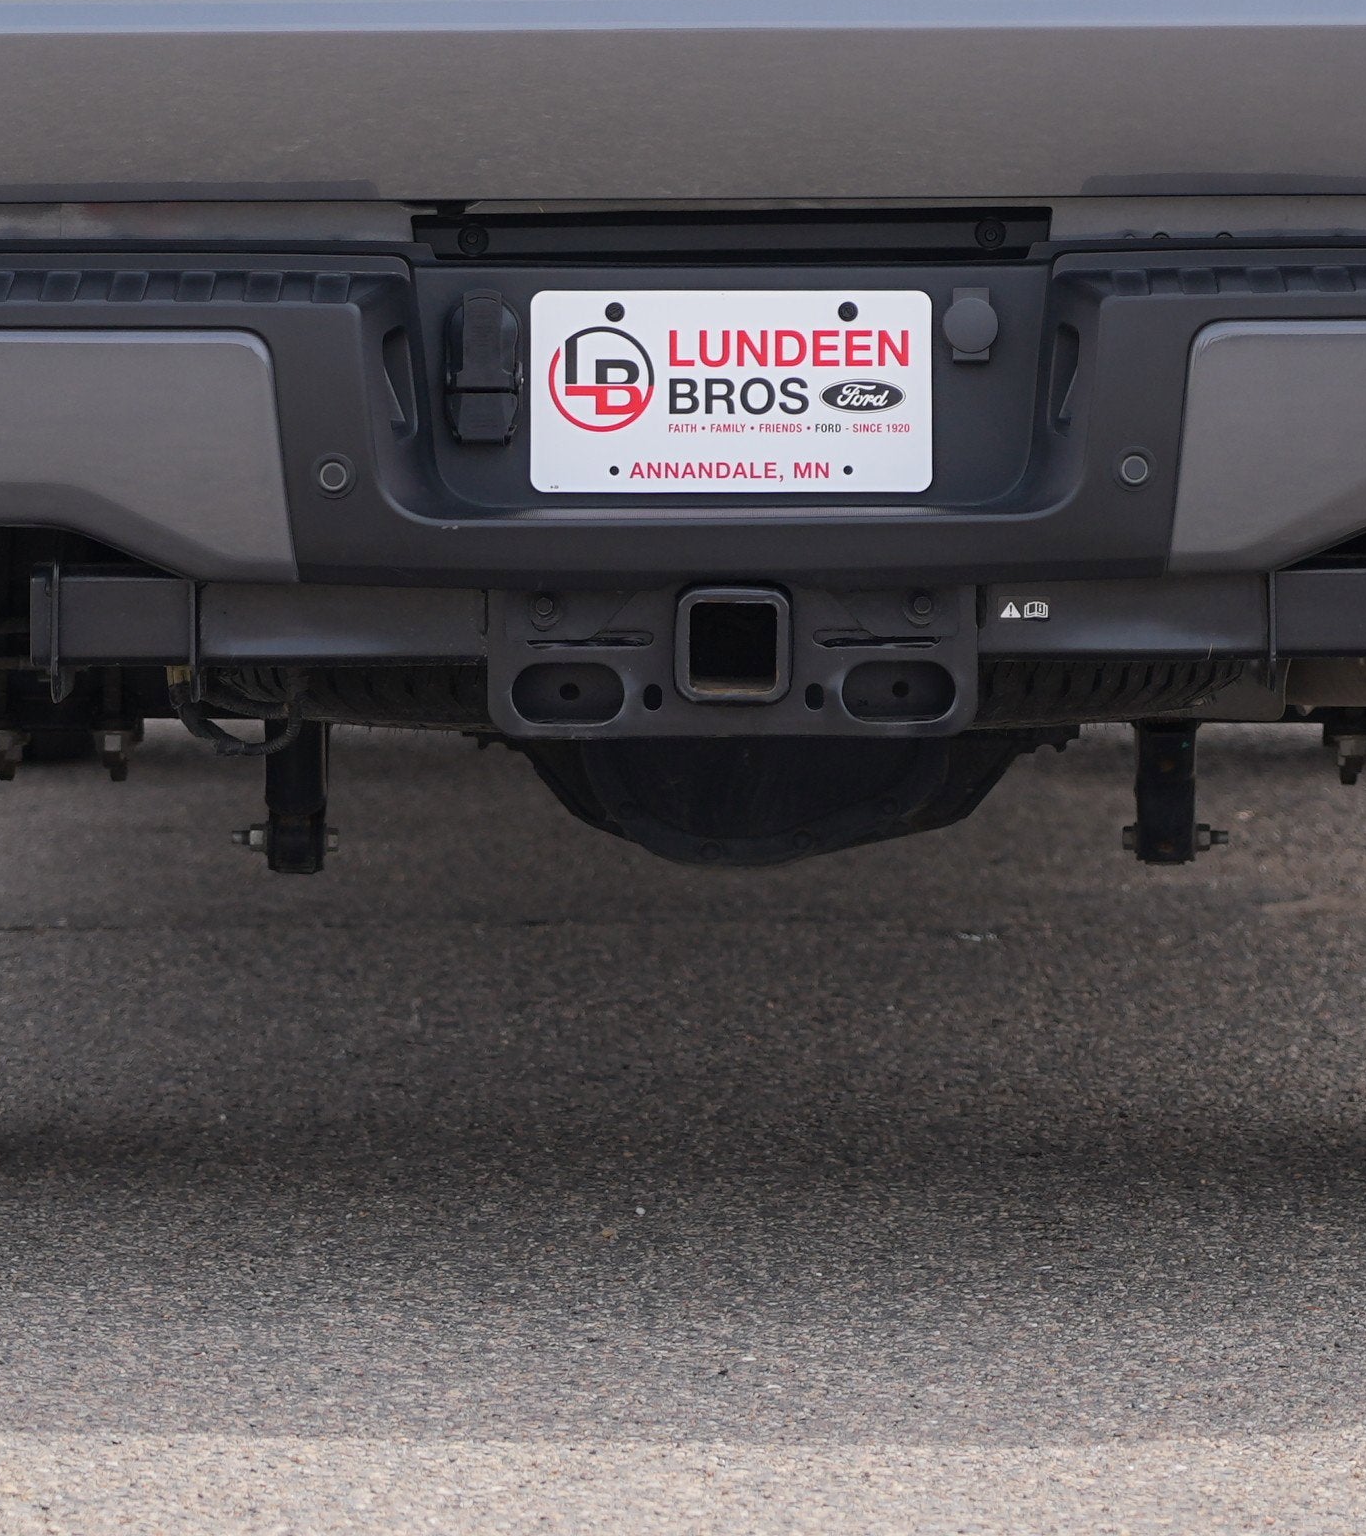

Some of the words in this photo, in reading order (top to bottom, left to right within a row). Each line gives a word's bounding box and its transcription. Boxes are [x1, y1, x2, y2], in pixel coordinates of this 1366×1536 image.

[668, 329, 910, 368] LUNDEEN
[668, 377, 810, 416] BROS
[836, 383, 889, 407] Ford
[668, 423, 697, 433] FAITH
[710, 423, 746, 433] FAMILY
[759, 423, 803, 433] FRIENDS
[815, 423, 842, 433] FORD
[852, 423, 883, 433] SINCE
[886, 423, 910, 433] 1920
[629, 461, 784, 483] ANNANDALE,
[793, 461, 830, 479] MN
